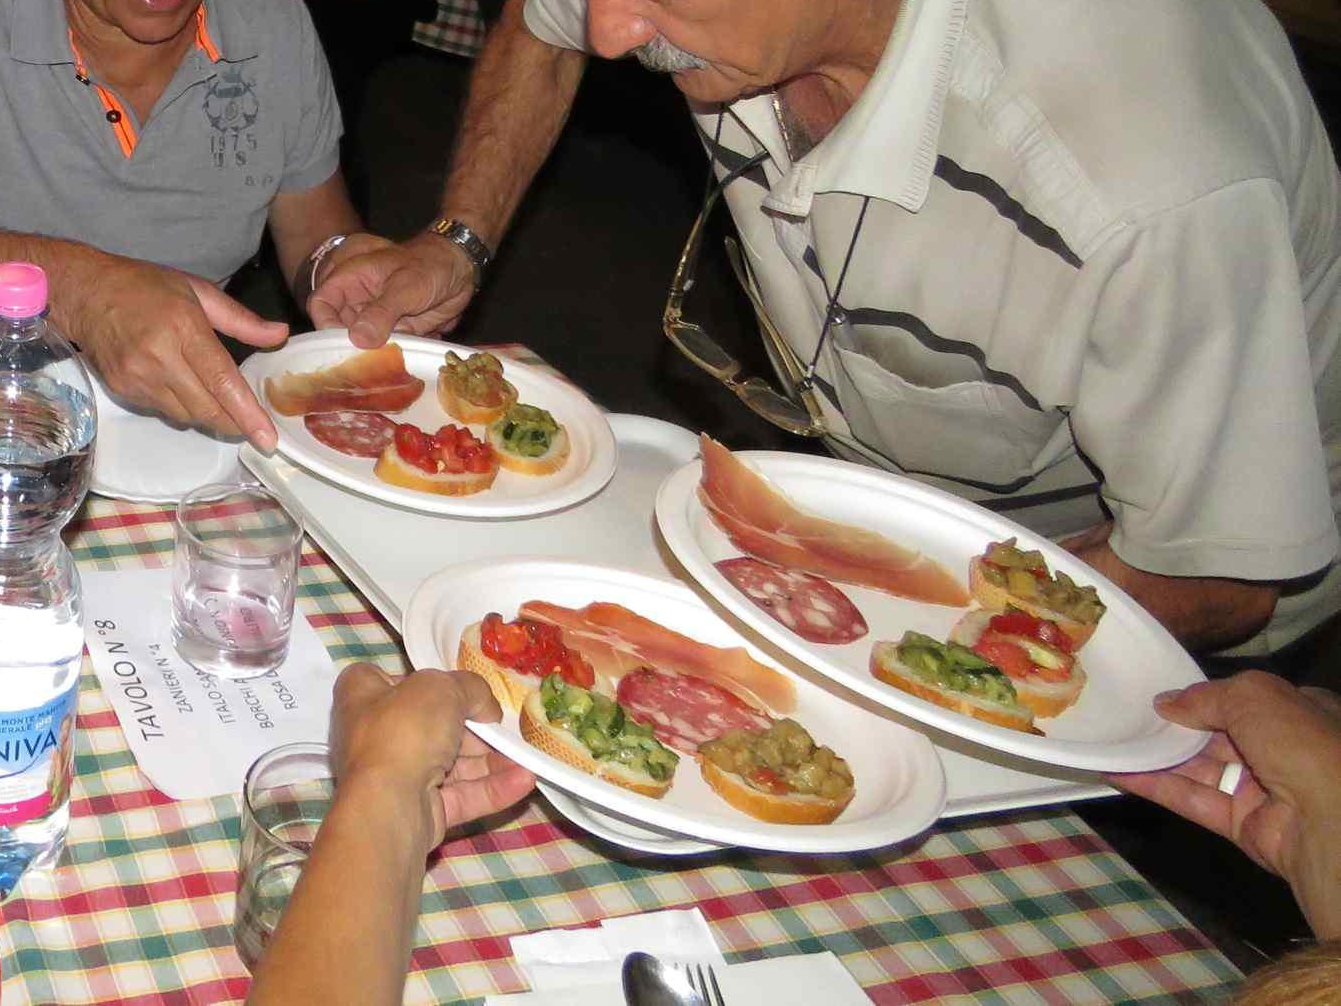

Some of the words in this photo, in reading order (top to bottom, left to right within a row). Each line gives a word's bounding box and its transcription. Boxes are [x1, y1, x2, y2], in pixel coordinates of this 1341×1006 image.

[113, 661, 164, 741] TAVOLO
[162, 668, 194, 714] ZANIERI
[207, 690, 236, 725] ITALO
[273, 681, 298, 711] ROSA
[1, 714, 36, 726] MONTE
